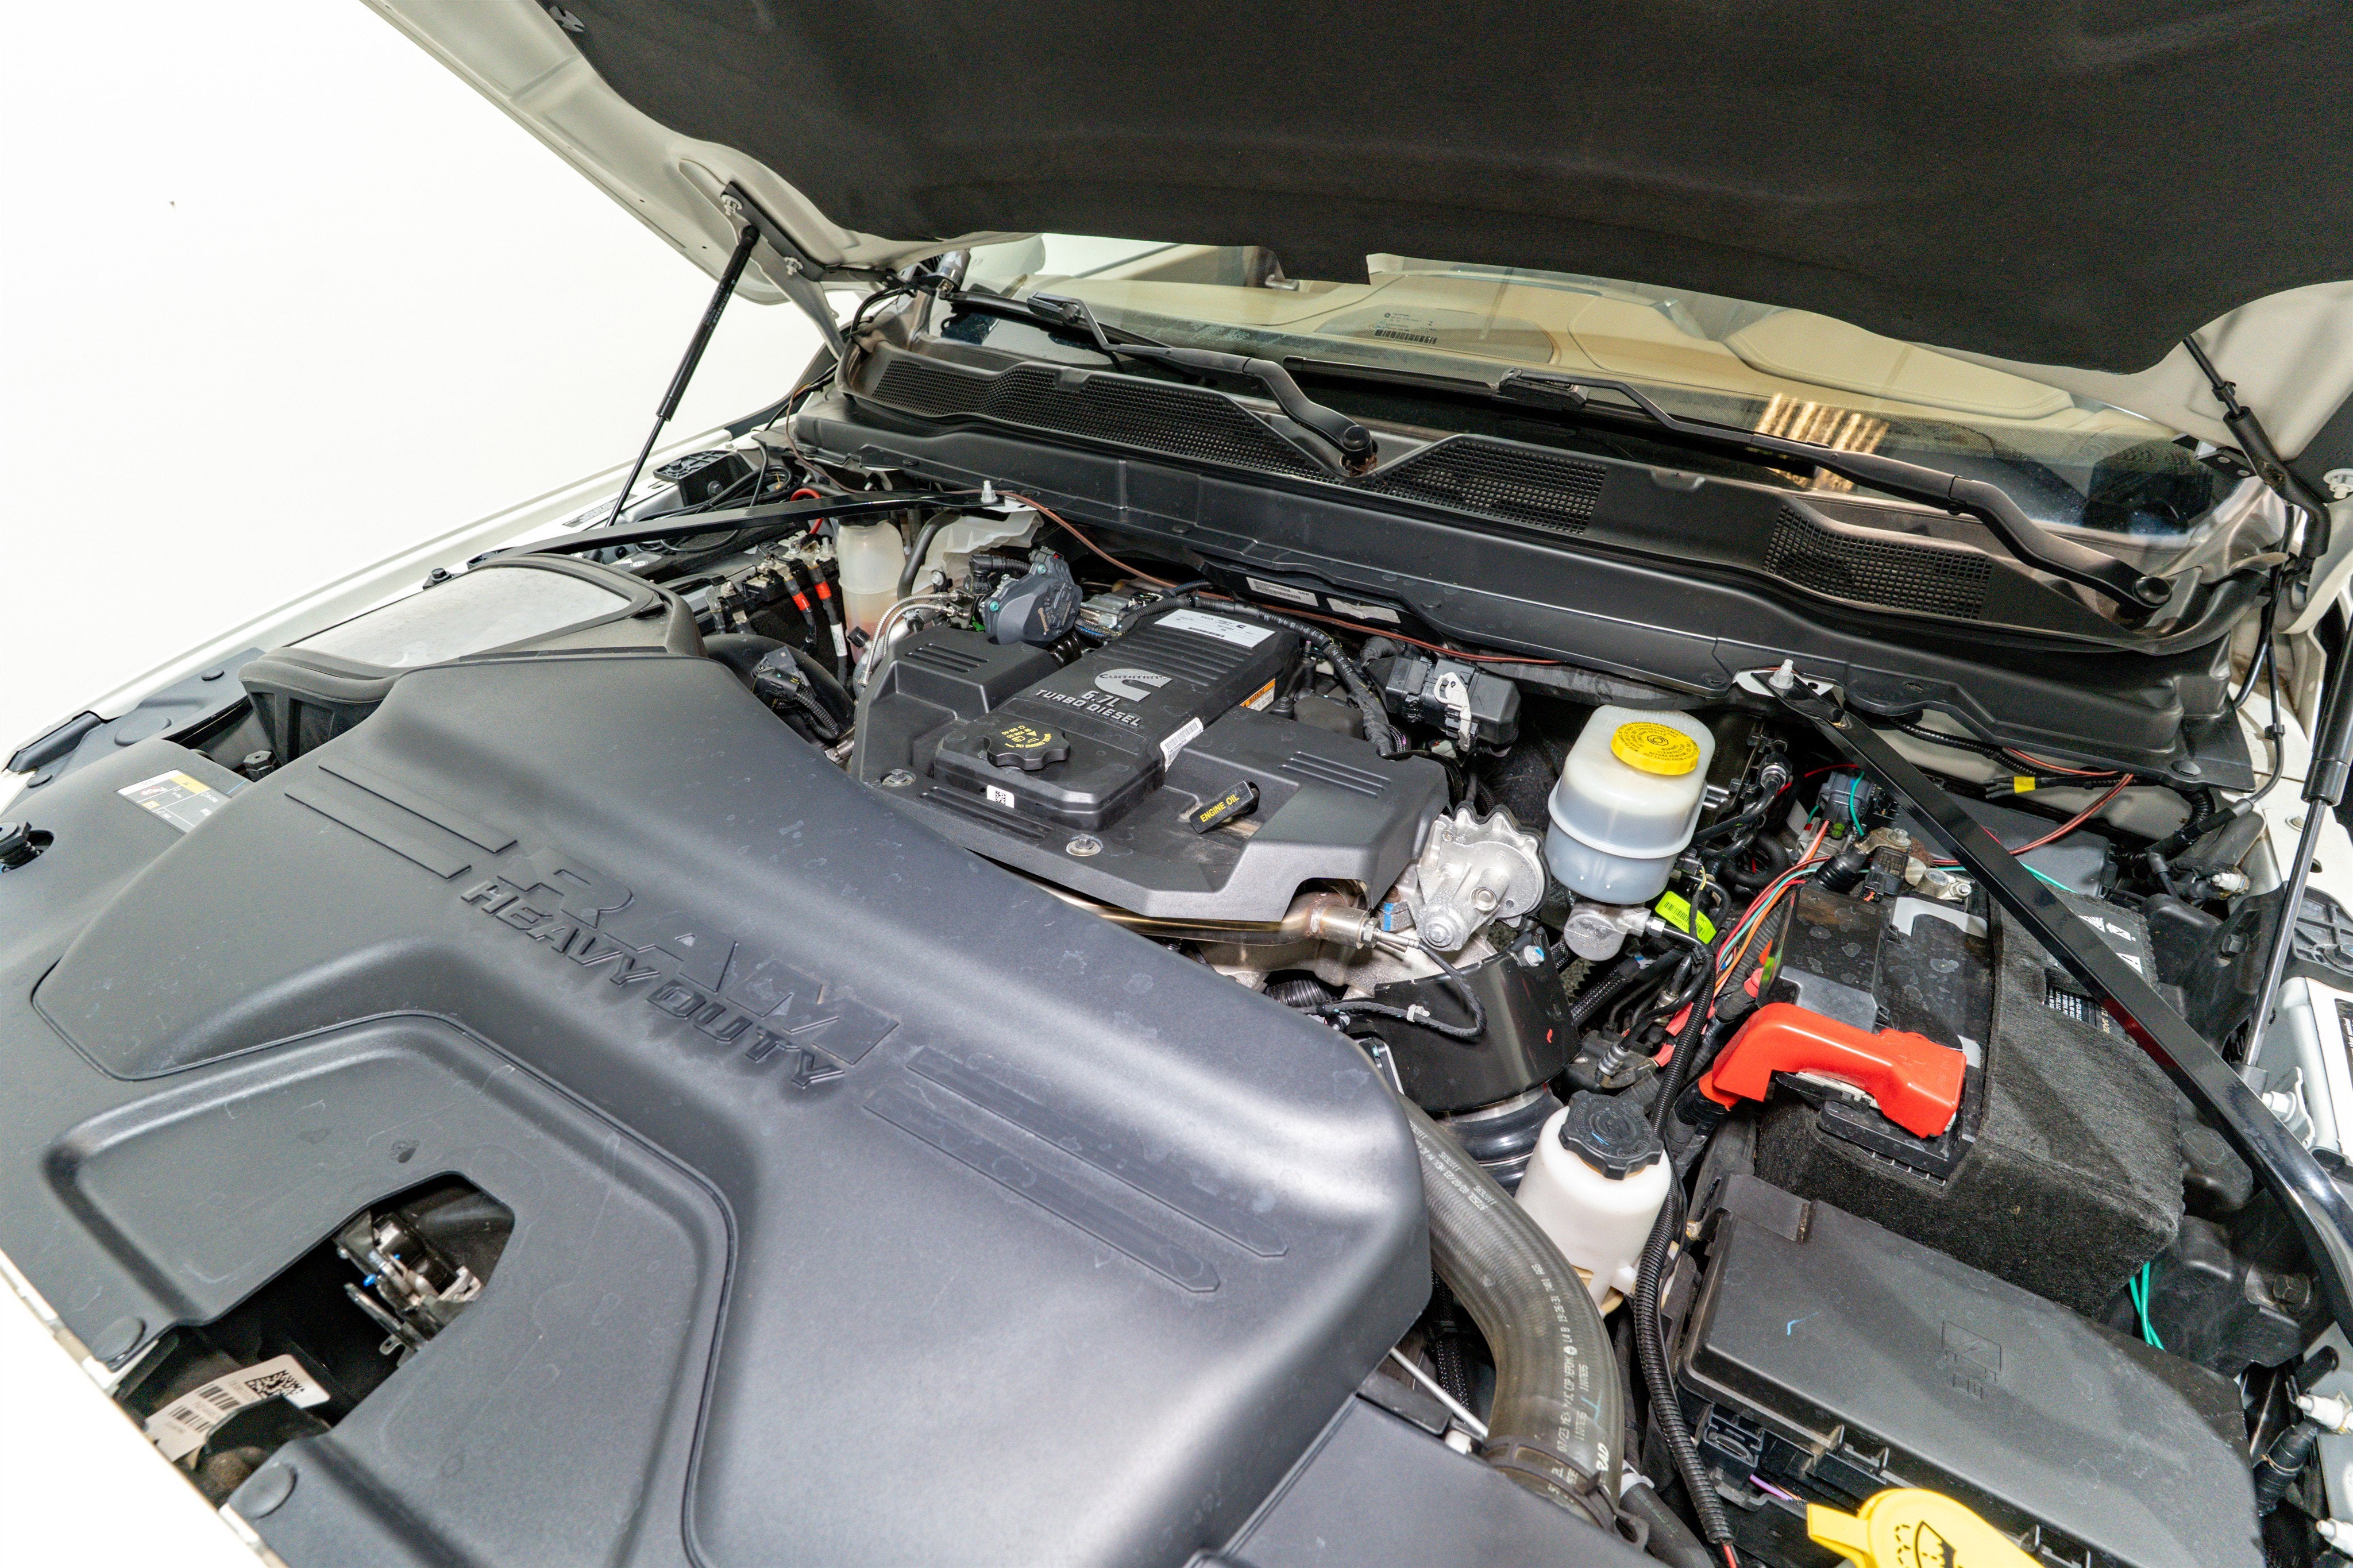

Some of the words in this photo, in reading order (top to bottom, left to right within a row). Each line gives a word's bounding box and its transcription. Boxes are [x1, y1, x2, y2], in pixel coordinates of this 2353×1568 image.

[1035, 689, 1087, 708] TURBO
[1086, 704, 1141, 728] DIESEL
[1081, 690, 1121, 708] 6.7L
[1199, 801, 1226, 822] ENGINE
[1225, 794, 1240, 805] OIL
[497, 845, 900, 1065] RAM
[460, 879, 662, 987] HEAVY
[646, 979, 846, 1088] DUTY
